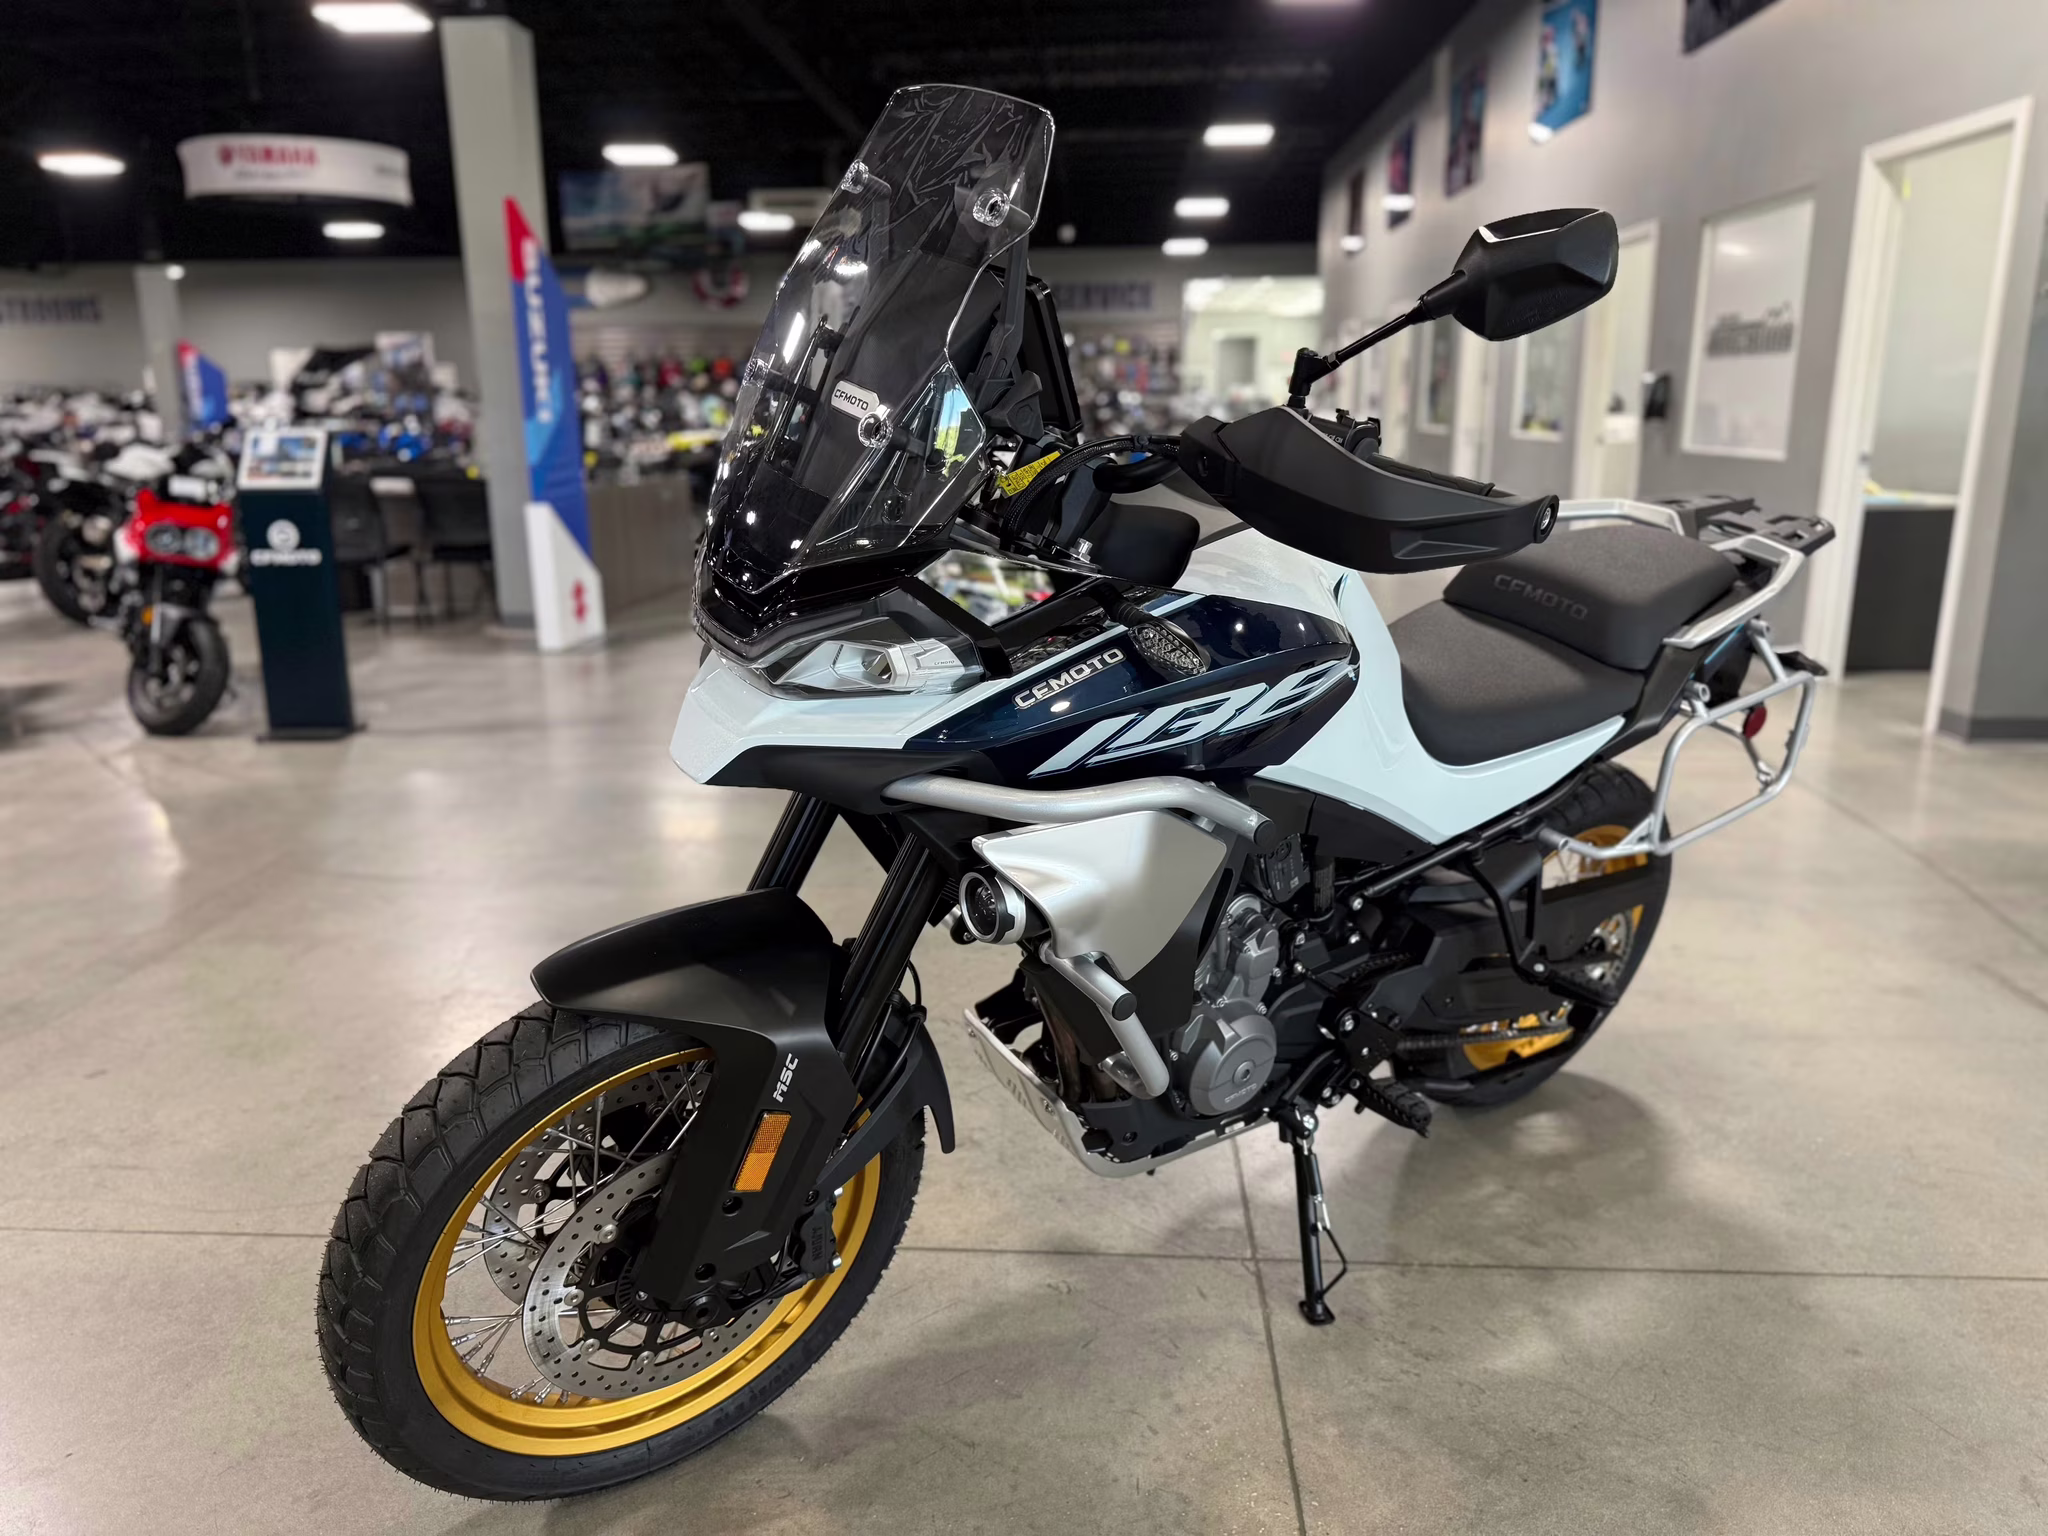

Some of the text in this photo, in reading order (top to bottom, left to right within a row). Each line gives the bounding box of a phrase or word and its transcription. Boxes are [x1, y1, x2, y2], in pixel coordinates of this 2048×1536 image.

[834, 388, 869, 411] CFMOTO
[1494, 574, 1588, 620] CFMOTO
[1013, 647, 1125, 709] CFMOTO
[772, 1052, 799, 1103] MSC
